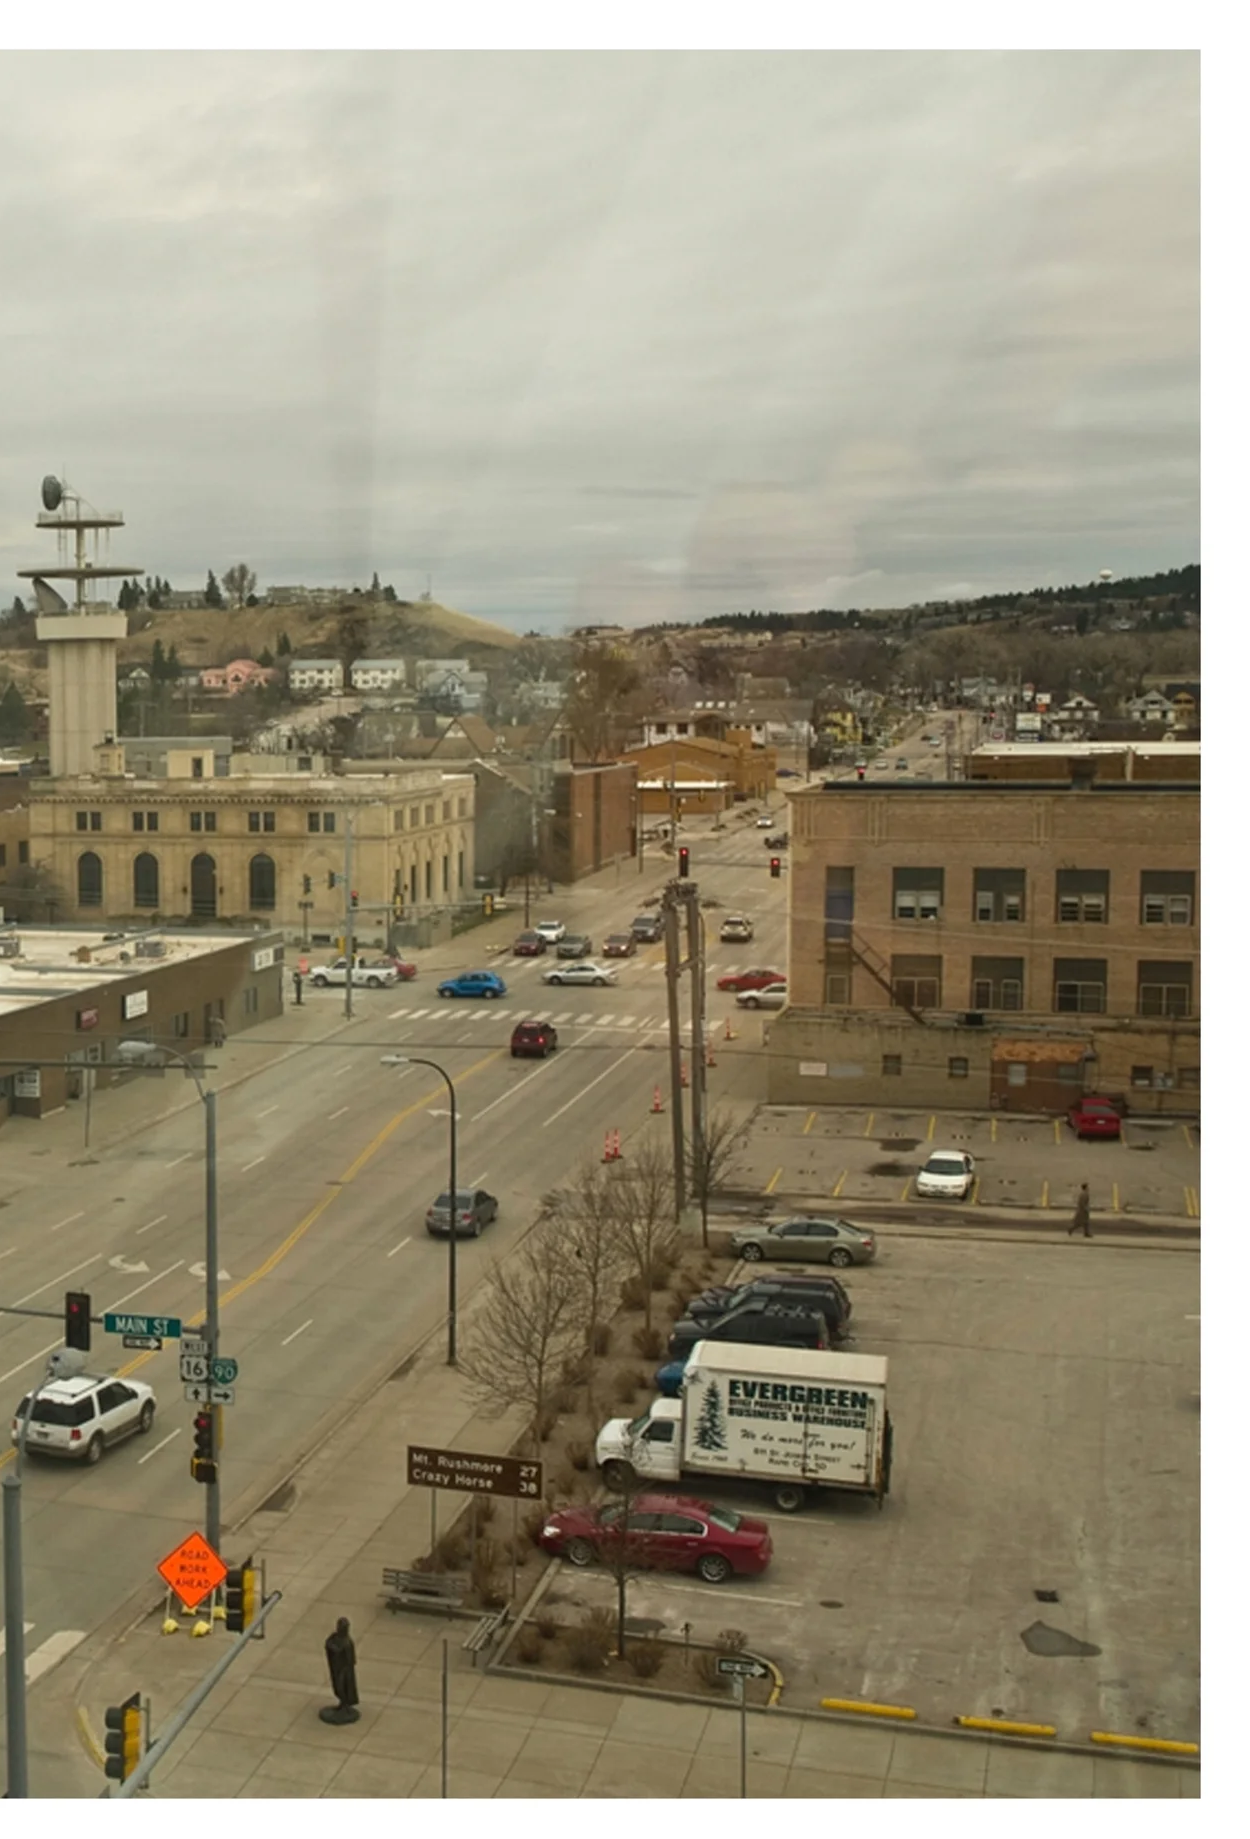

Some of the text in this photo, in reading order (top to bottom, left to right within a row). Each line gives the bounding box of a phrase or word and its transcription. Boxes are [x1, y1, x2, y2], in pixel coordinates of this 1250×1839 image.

[114, 1316, 169, 1336] MAIN ST
[185, 1360, 204, 1377] 16
[214, 1364, 235, 1381] 90
[729, 1380, 868, 1409] EVERGREEN
[727, 1407, 867, 1430] BUSINESS WAREHOUSE
[412, 1452, 538, 1478] Mt. Rushmore 27
[412, 1468, 450, 1485] Crazy
[454, 1473, 493, 1489] Horse
[180, 1549, 210, 1560] ROAD
[175, 1577, 211, 1589] AHEAD
